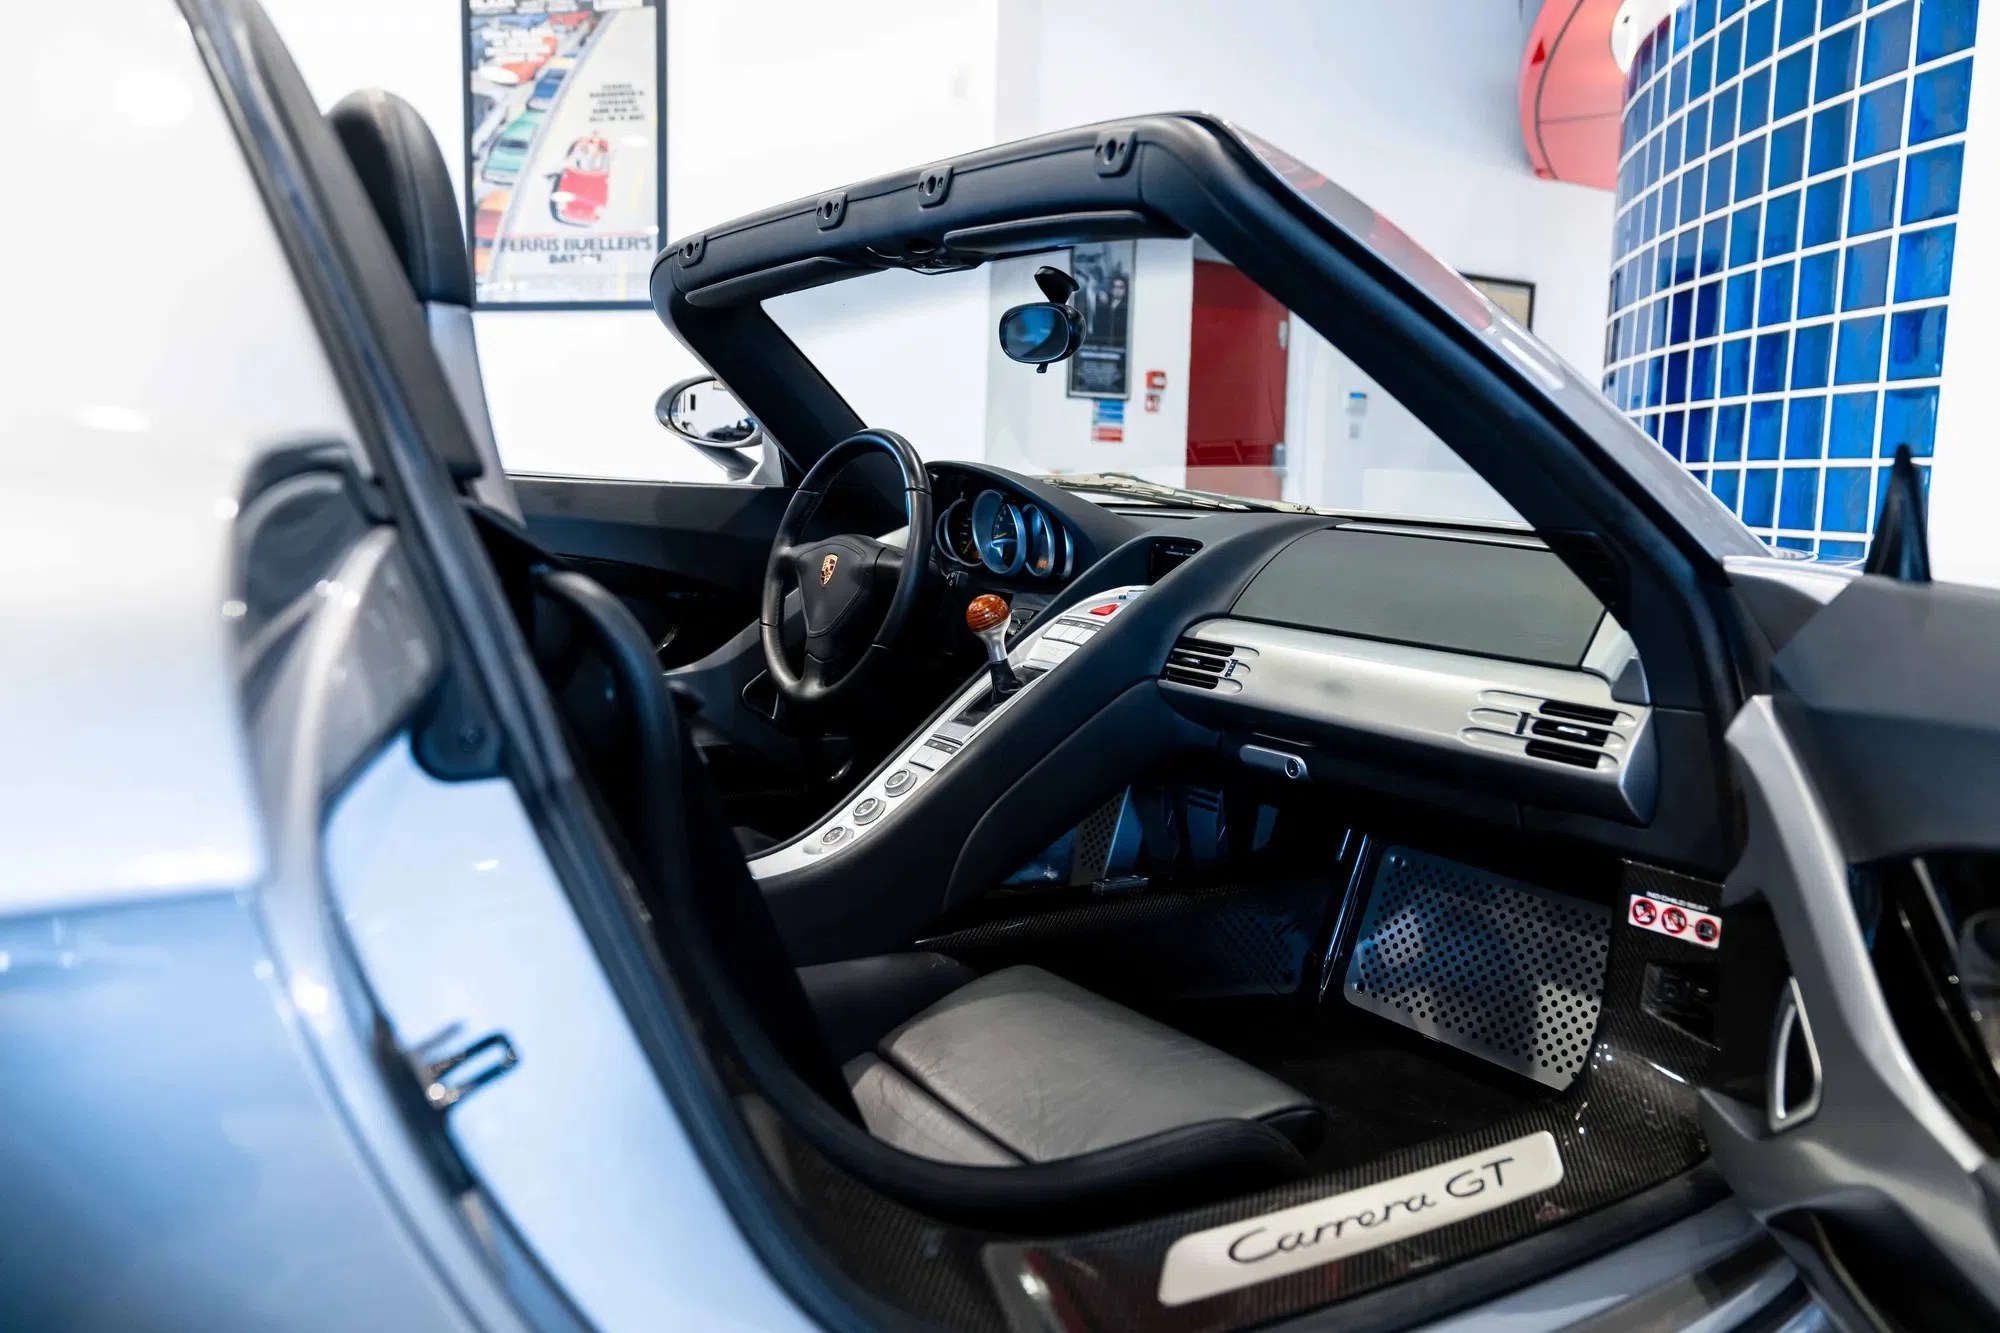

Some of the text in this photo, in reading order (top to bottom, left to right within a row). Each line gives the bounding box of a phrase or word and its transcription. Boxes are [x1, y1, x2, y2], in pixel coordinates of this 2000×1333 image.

[564, 236, 652, 251] BUELLER'S
[1228, 1155, 1514, 1265] Carrera GT
